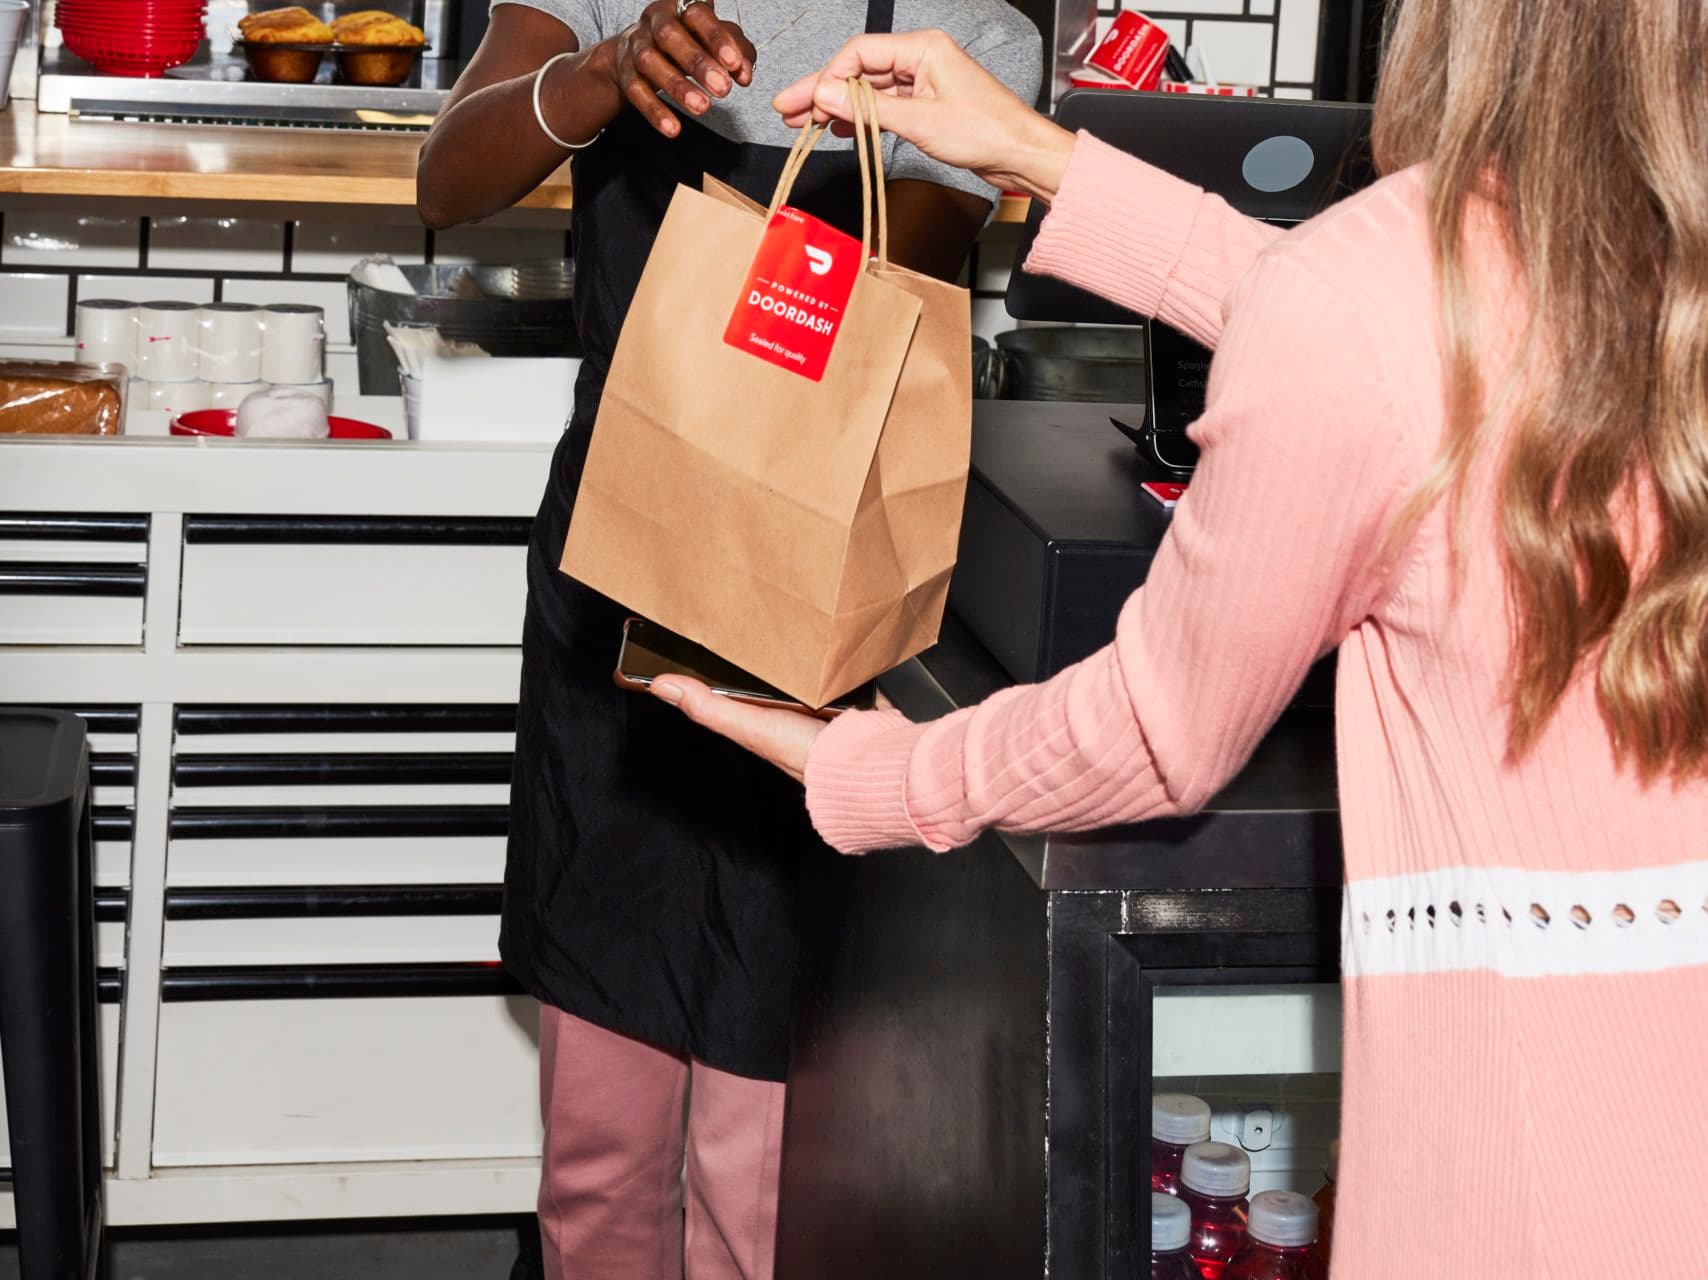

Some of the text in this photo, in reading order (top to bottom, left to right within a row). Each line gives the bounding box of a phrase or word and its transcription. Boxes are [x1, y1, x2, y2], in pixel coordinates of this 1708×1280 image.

[771, 281, 830, 310] POWERED BY
[748, 289, 834, 336] DOORDASH
[749, 332, 807, 365] Sealed for quality
